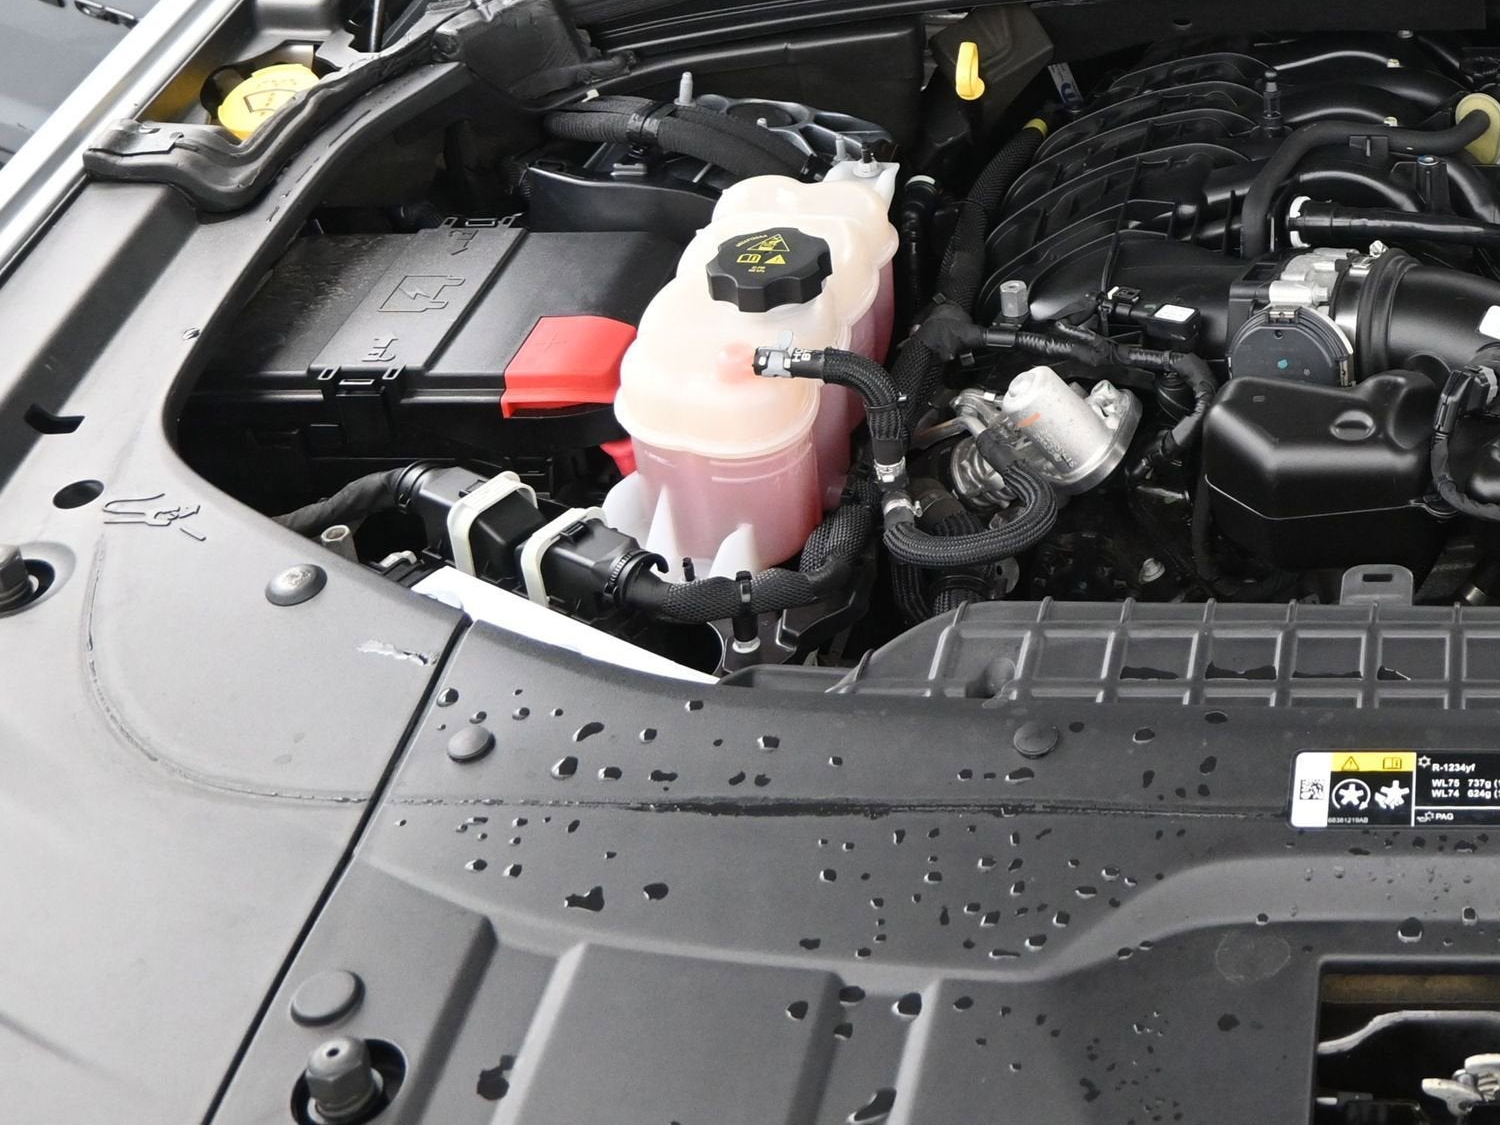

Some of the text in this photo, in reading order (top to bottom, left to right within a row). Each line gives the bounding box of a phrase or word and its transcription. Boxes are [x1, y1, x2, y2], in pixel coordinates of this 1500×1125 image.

[1431, 762, 1476, 774] R-1234yf
[1431, 779, 1461, 788] WL75
[1467, 779, 1492, 789] 737g
[1431, 789, 1460, 798] WL74
[1467, 789, 1492, 800] 624g
[1435, 812, 1455, 821] PAG
